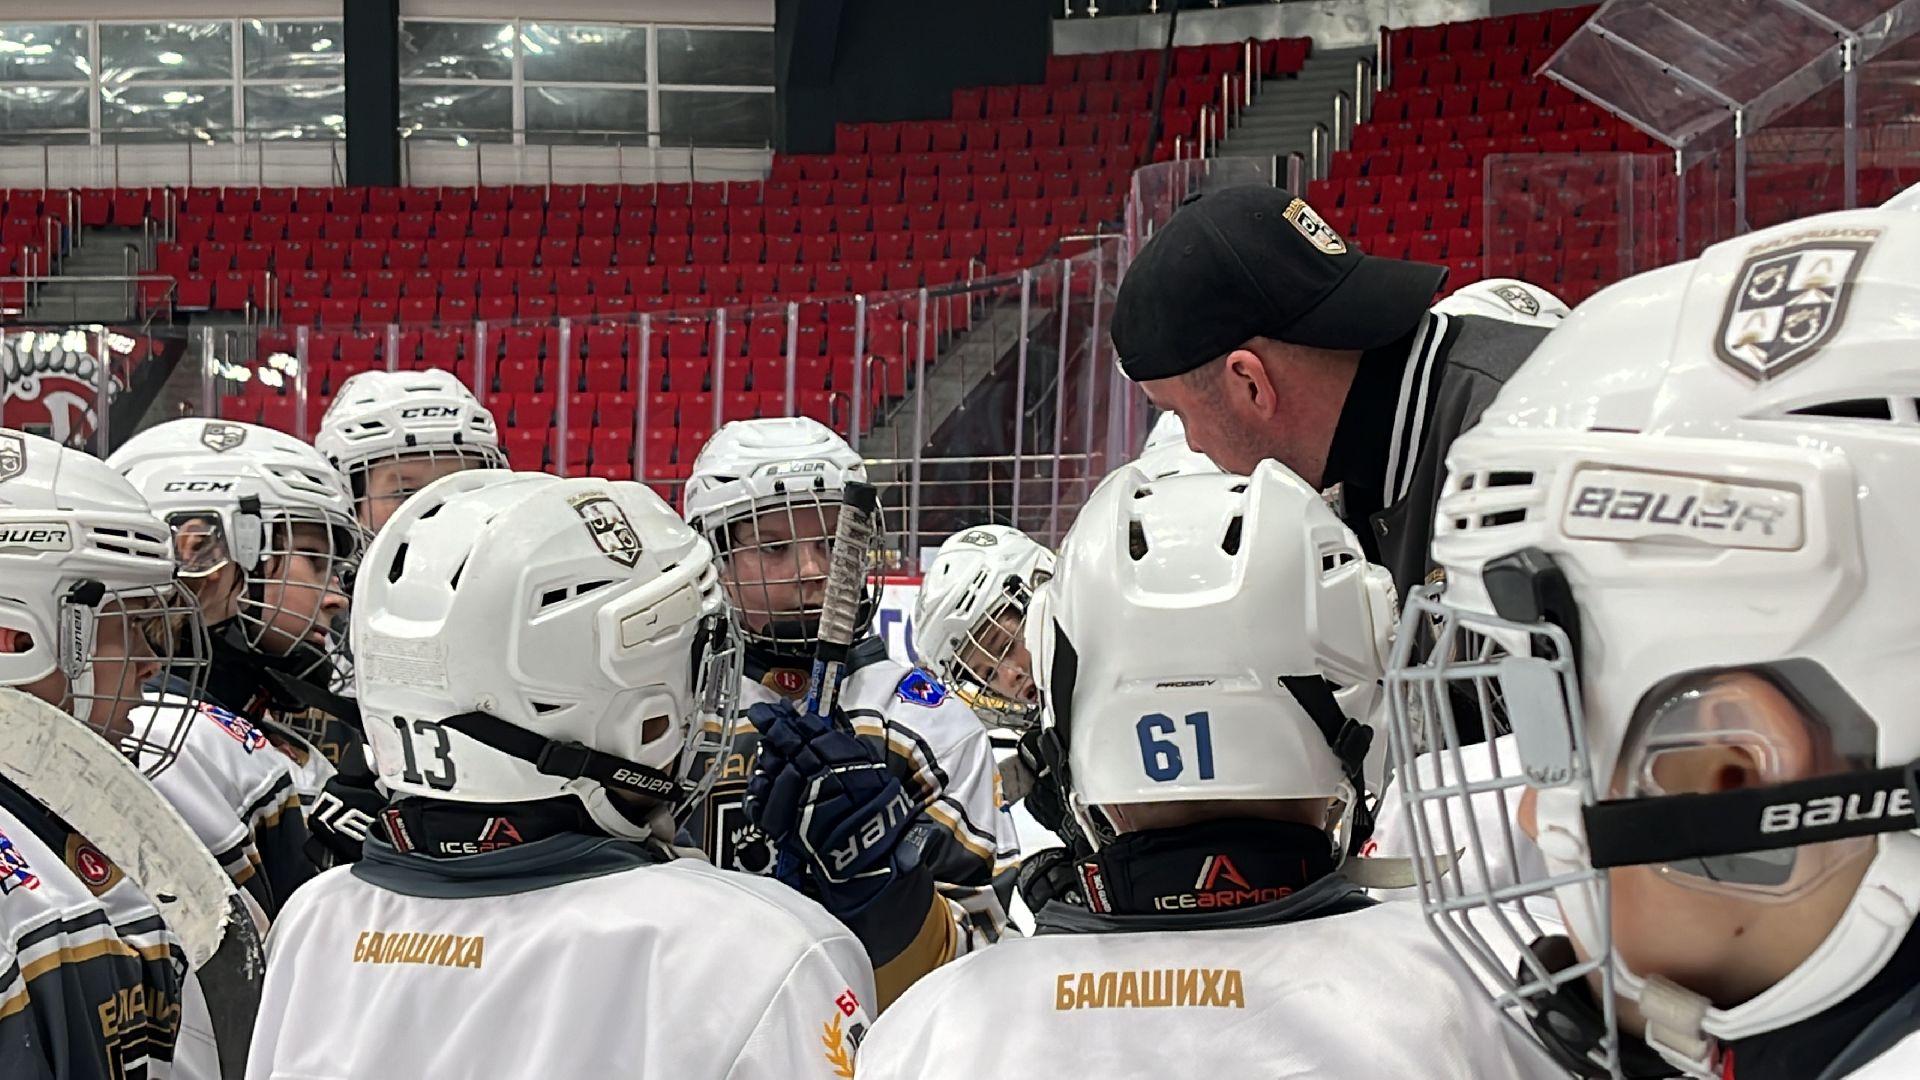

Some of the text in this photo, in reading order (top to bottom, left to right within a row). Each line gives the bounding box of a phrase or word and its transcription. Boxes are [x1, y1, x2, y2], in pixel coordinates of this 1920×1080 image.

[401, 407, 460, 418] CCM
[164, 481, 234, 493] CCM
[1155, 679, 1217, 688] PRODIGY
[394, 716, 457, 791] 13
[1136, 711, 1215, 782] 61
[354, 932, 484, 969] БАЛАШИХА
[1056, 968, 1245, 1010] БАЛАШИХА
